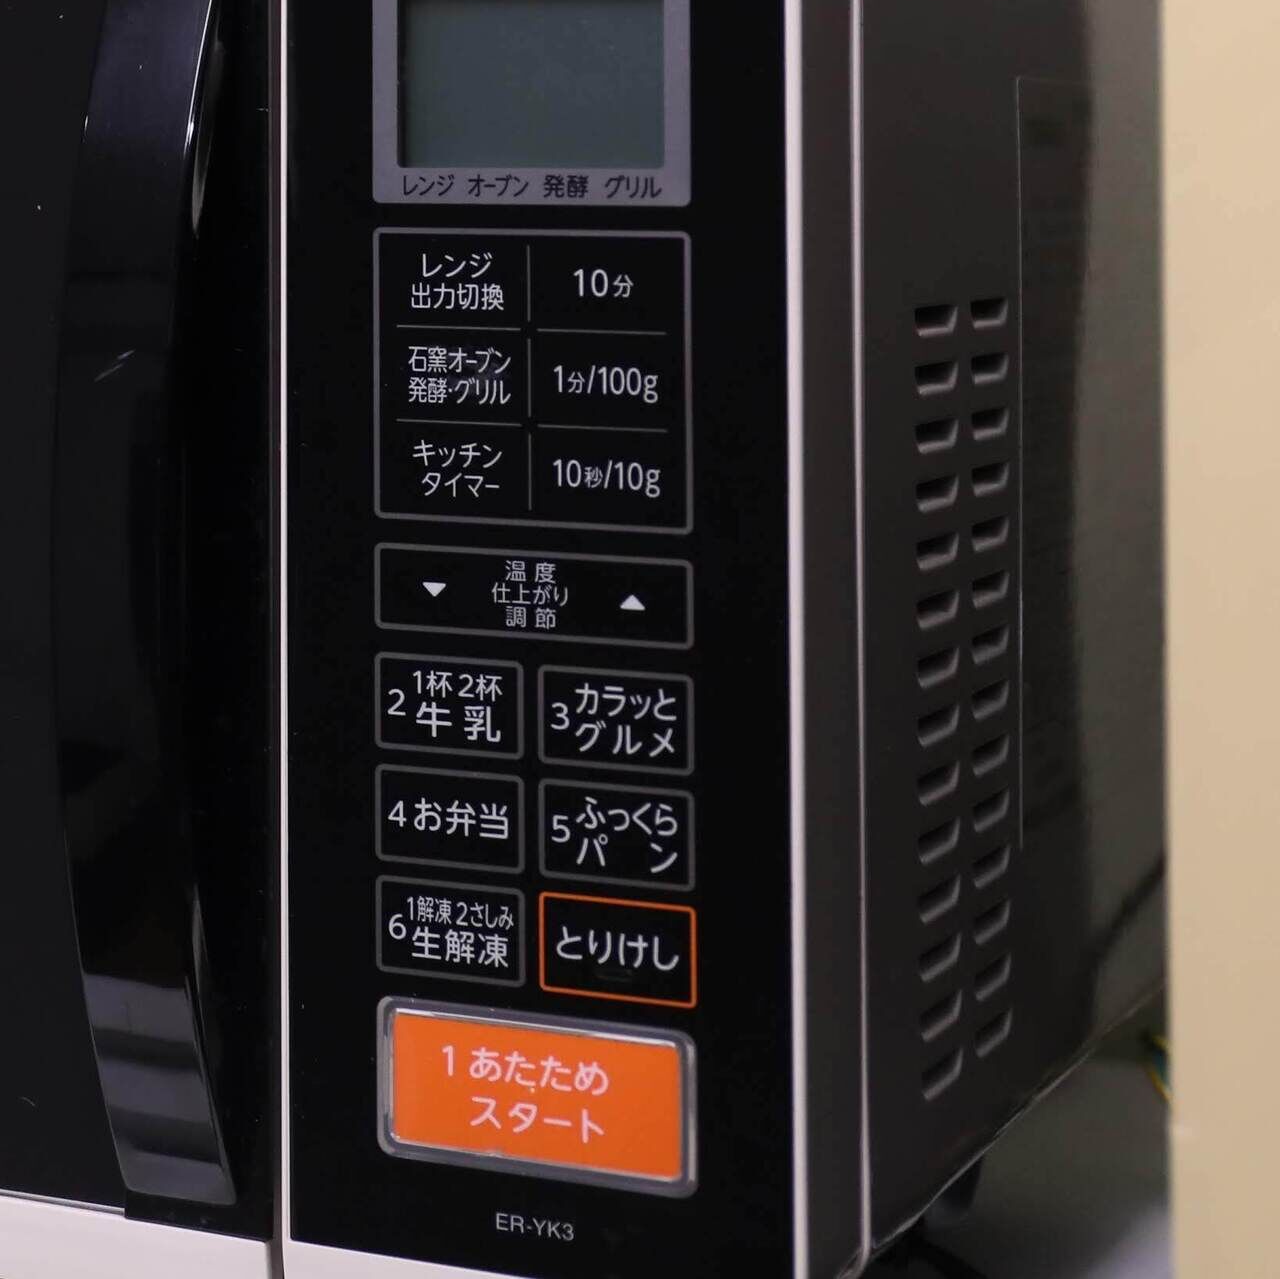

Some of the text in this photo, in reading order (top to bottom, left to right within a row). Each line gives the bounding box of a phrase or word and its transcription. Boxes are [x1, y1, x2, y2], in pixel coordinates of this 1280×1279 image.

[403, 174, 662, 199] レンジ オーブン 発酵 グリル
[422, 251, 493, 279] レンジ
[411, 282, 505, 311] 出力切換
[573, 268, 634, 298] 10分
[408, 345, 512, 375] 石窯オーブン
[553, 364, 659, 404] 1分/100g
[412, 439, 503, 469] キッチン
[421, 472, 500, 498] タイマー
[552, 458, 661, 498] 10秒/10g
[491, 582, 569, 607] 仕上がり
[412, 670, 503, 702] 1杯 2杯
[387, 688, 407, 716] 2
[550, 702, 570, 730] 3
[575, 683, 677, 721] カラッと
[575, 720, 675, 757] グルメ
[551, 814, 571, 843] 5
[576, 796, 679, 837] ふっくら
[411, 927, 509, 968] 生解凍
[556, 925, 680, 971] とりけし
[441, 1044, 610, 1096] 1 あたため
[470, 1096, 605, 1144] スタート
[495, 1212, 575, 1241] ER-YK3
